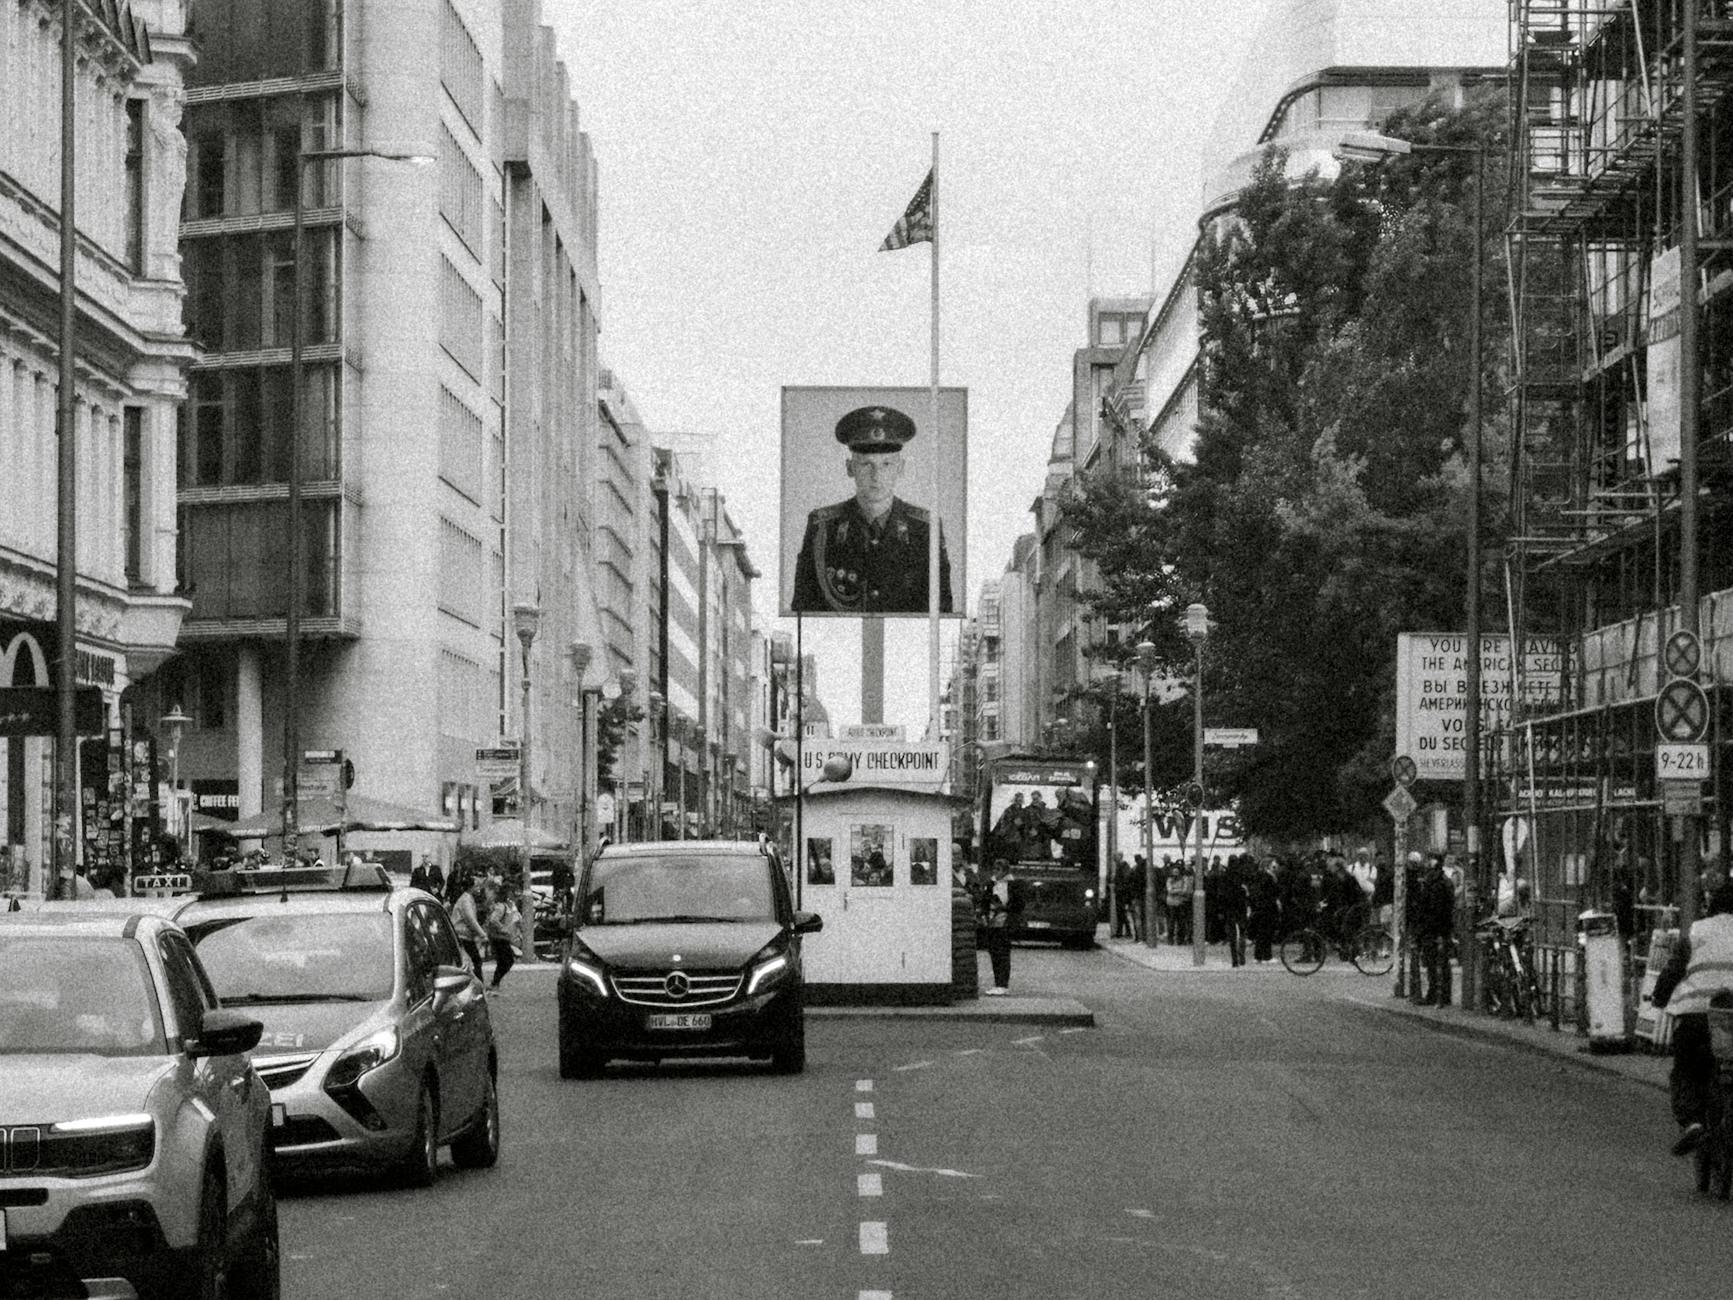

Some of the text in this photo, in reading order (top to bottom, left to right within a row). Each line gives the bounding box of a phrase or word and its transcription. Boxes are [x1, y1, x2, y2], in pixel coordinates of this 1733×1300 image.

[1430, 639, 1461, 652] YOU
[1483, 639, 1503, 652] RE
[1422, 656, 1445, 670] THE
[1442, 719, 1485, 732] VOS
[1420, 736, 1437, 750] DU
[867, 752, 940, 769] CHECKPOINT
[143, 875, 181, 888] TAXI
